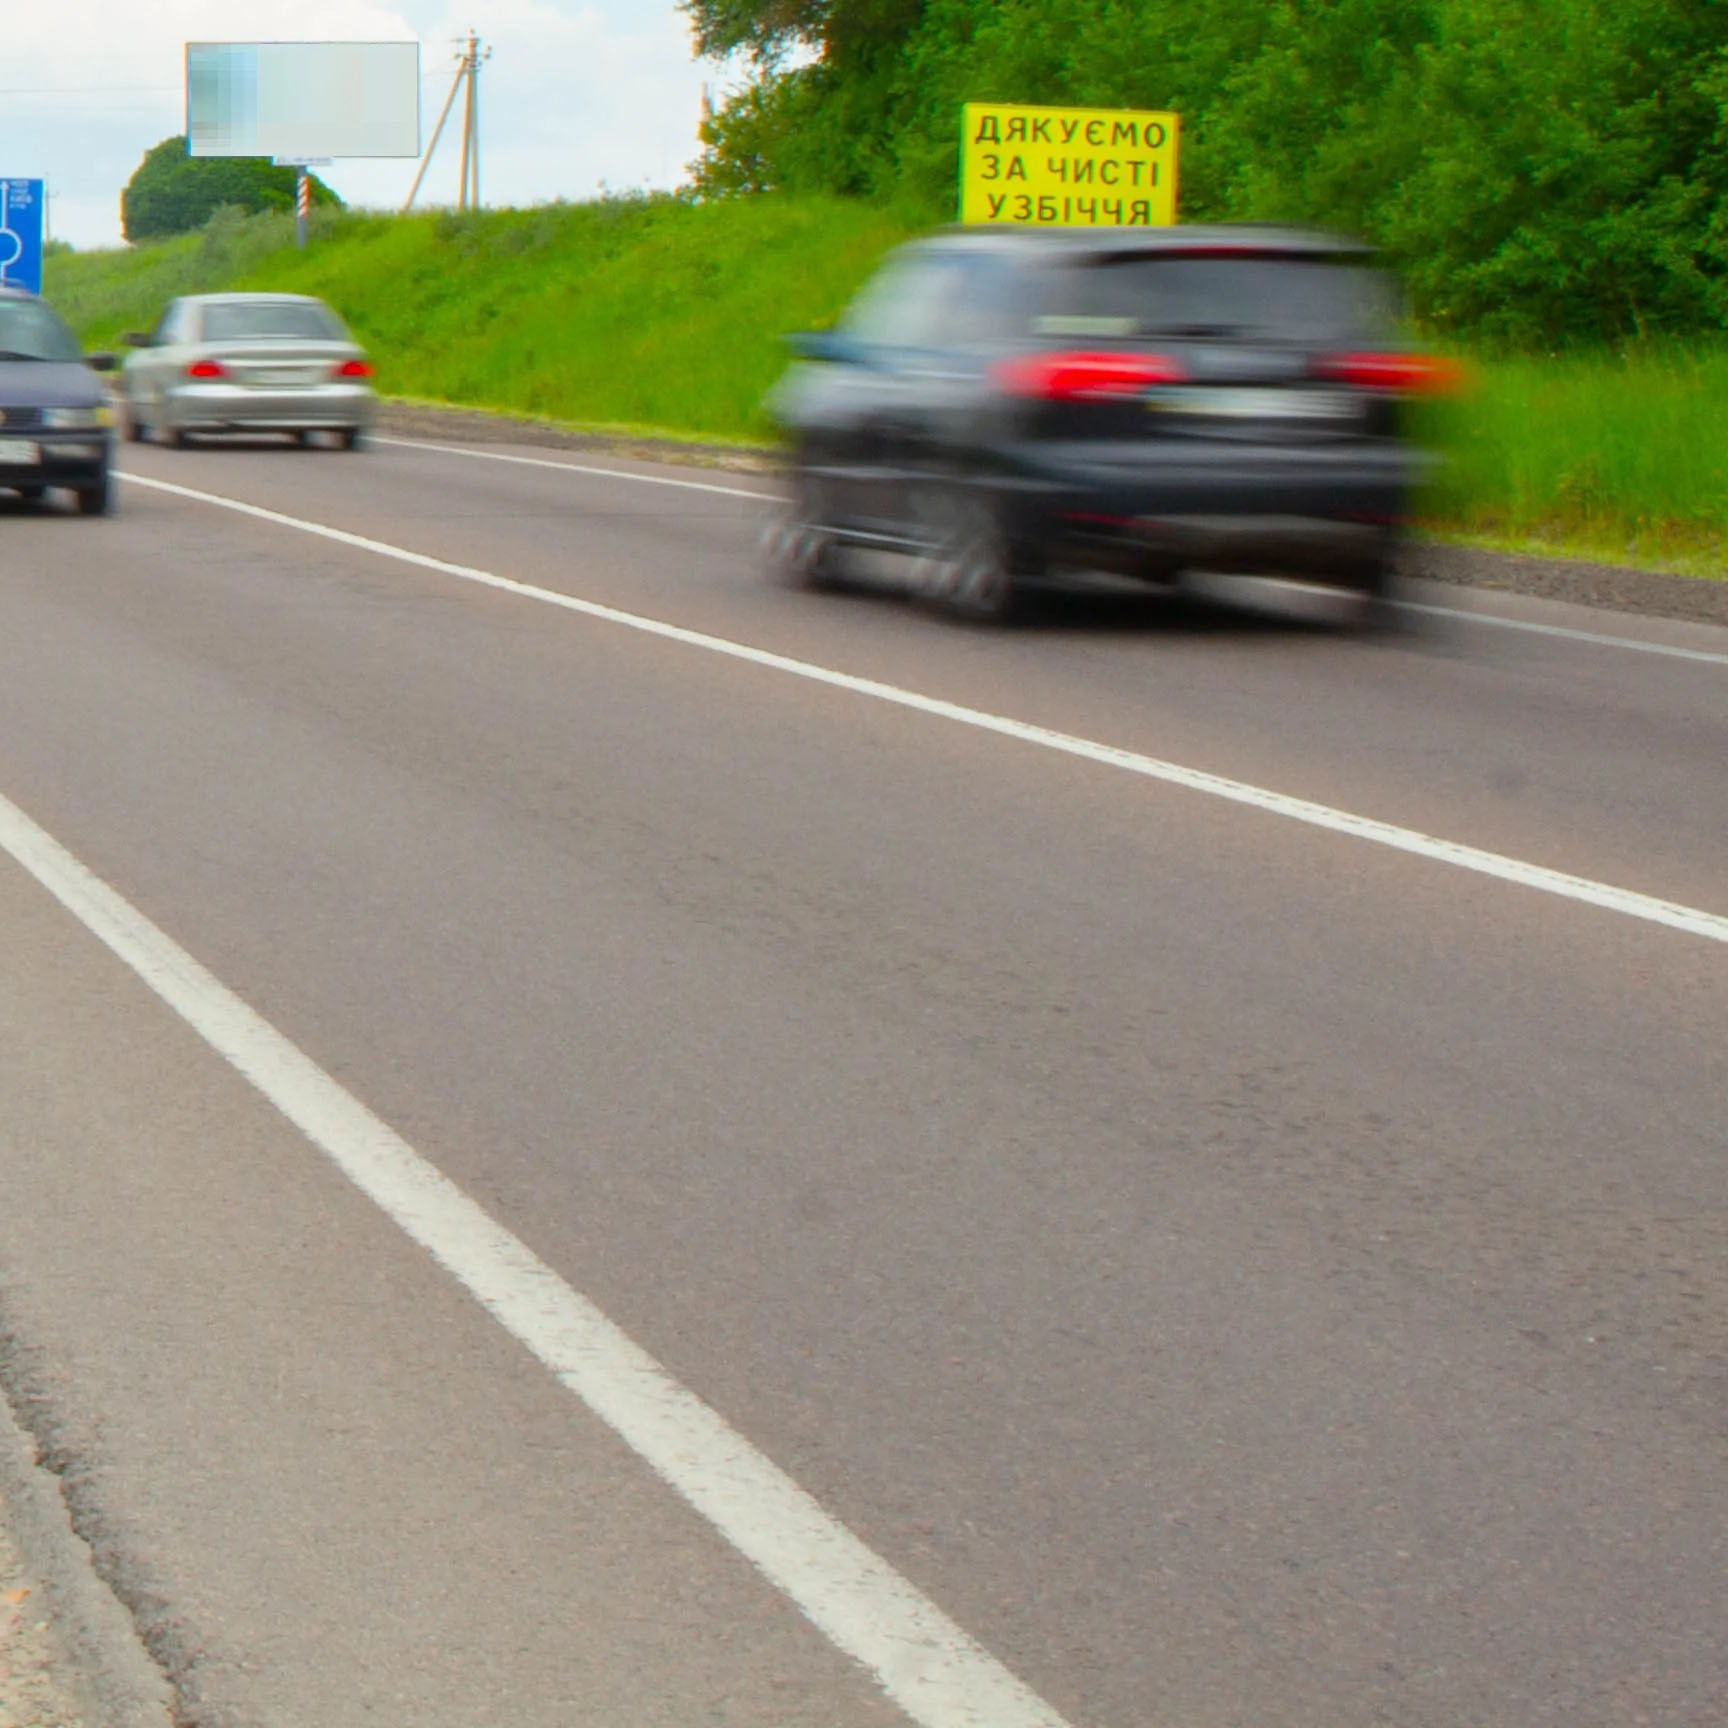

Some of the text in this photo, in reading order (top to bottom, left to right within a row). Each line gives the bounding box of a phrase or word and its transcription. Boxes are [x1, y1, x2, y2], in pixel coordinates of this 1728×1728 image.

[974, 115, 1166, 148] ДЯКУЄМО
[981, 154, 1158, 187] ЗА ЧИСТІ
[988, 193, 1150, 225] УЗБІЧЧЯ
